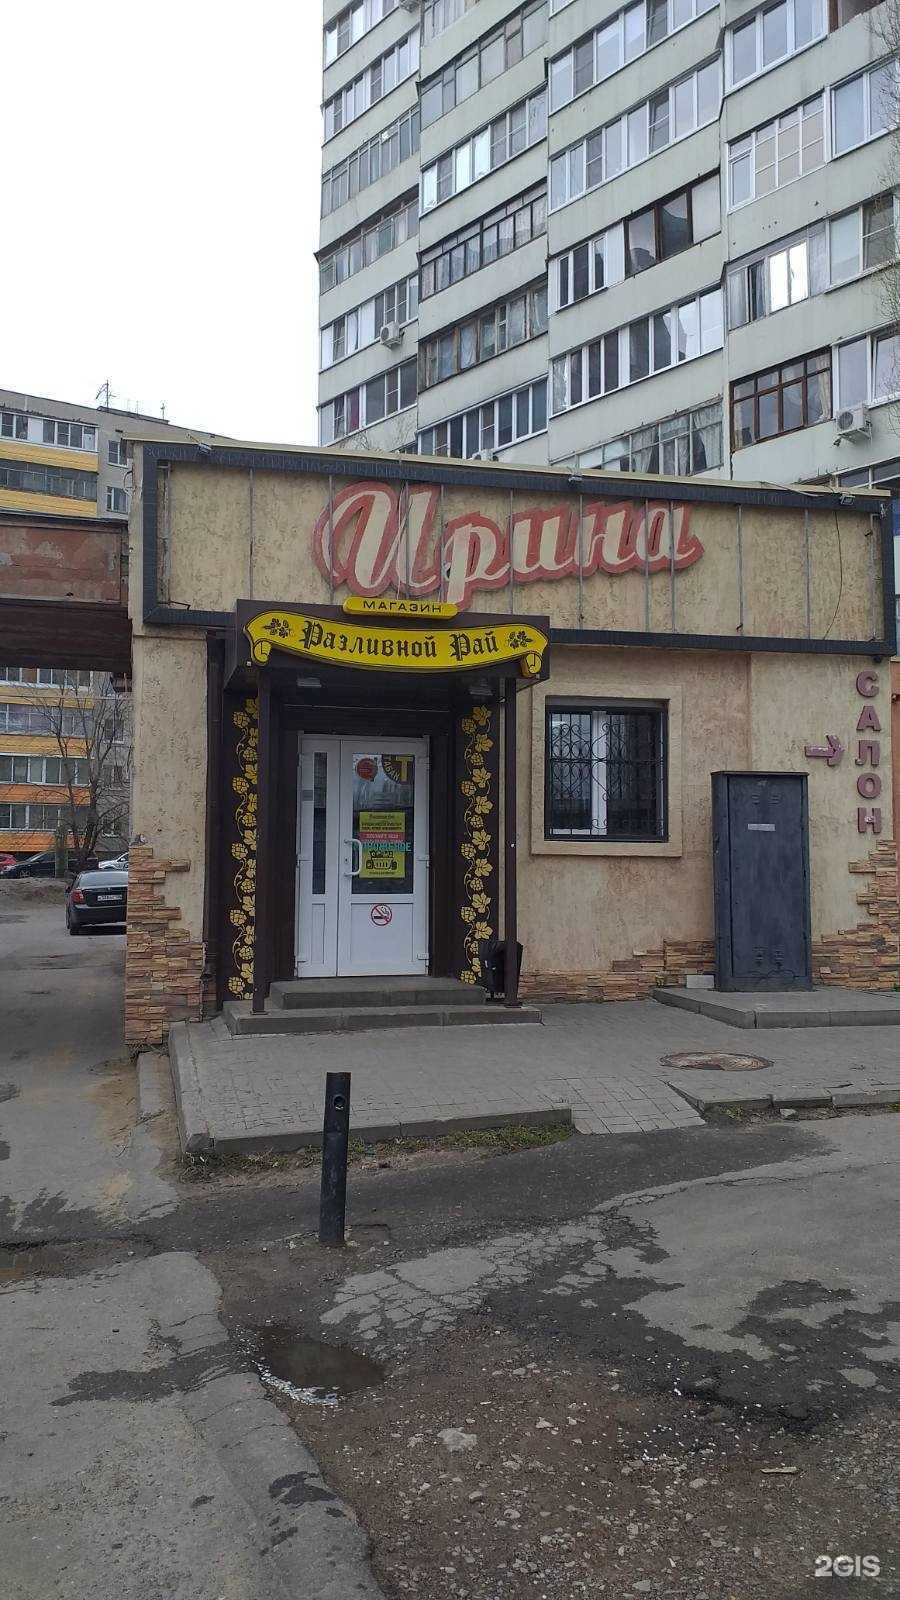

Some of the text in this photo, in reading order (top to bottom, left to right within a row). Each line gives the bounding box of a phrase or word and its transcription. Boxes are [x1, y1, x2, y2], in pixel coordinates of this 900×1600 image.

[314, 483, 703, 608] Ирина
[300, 620, 500, 661] Разливной Рай
[362, 600, 442, 614] МАГАЗИН
[855, 669, 881, 834] САЛОН
